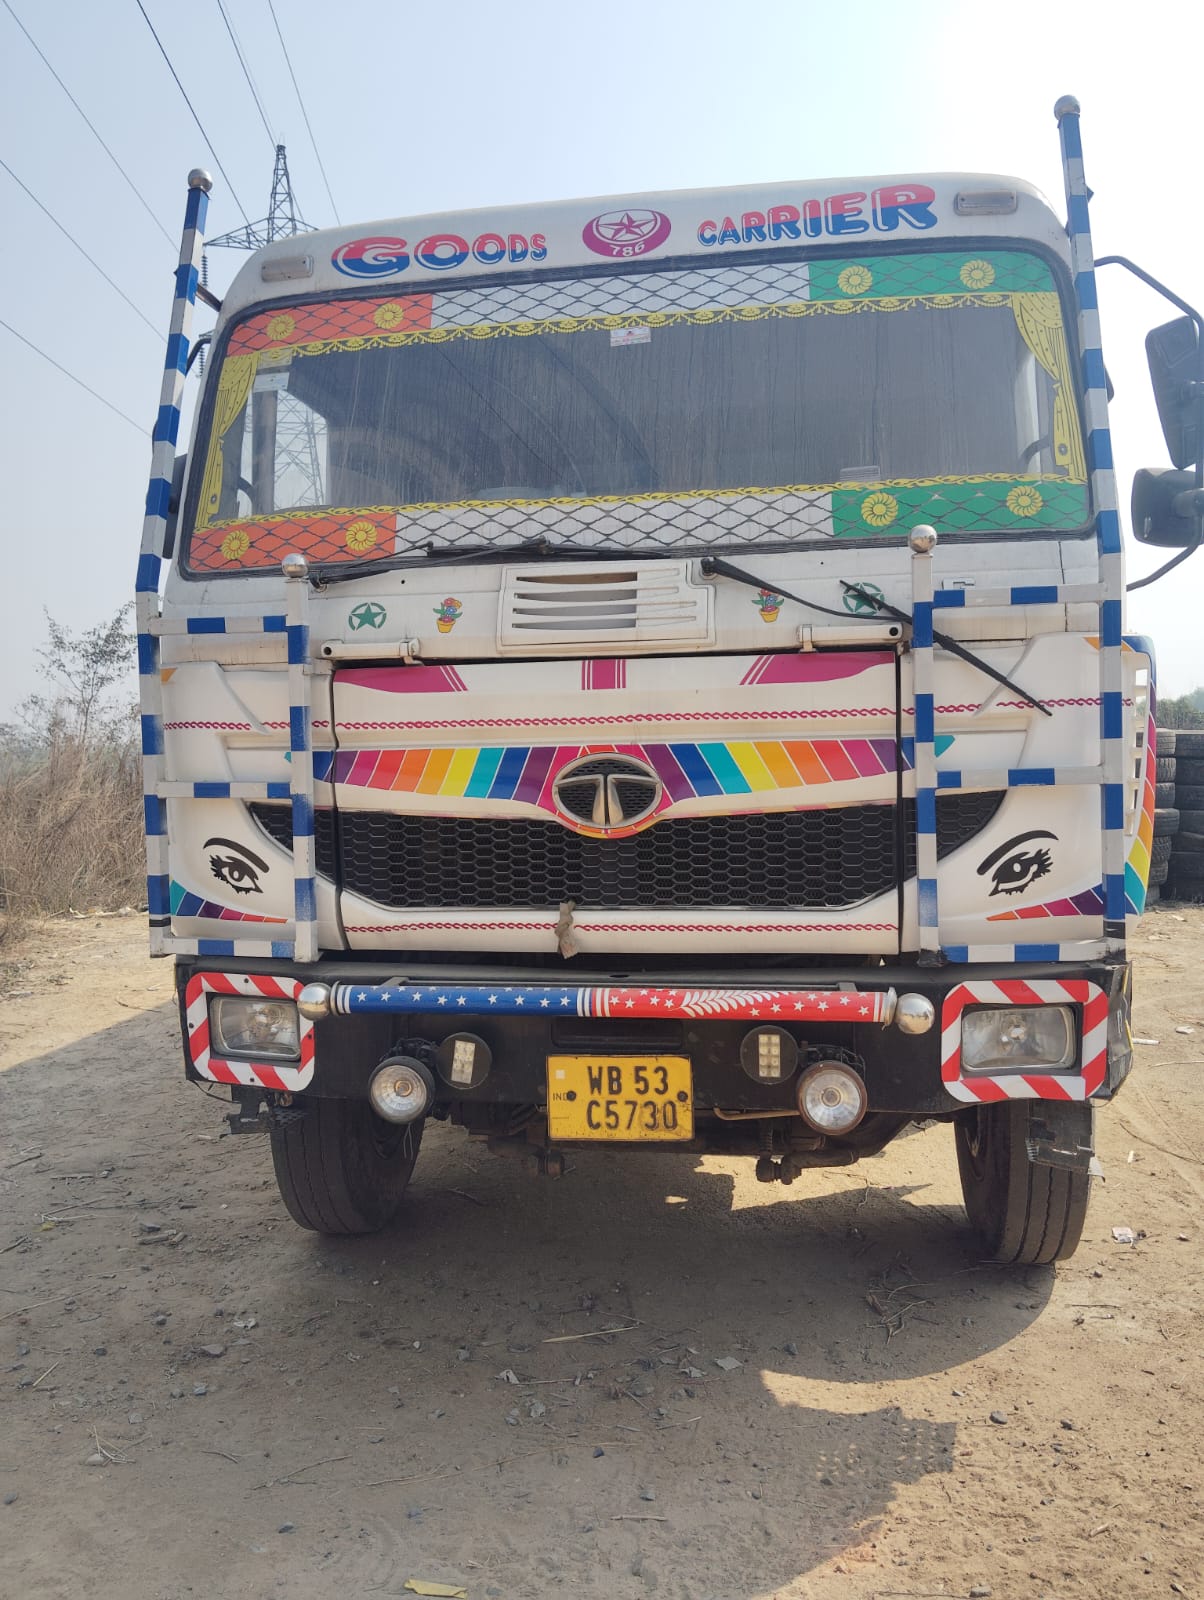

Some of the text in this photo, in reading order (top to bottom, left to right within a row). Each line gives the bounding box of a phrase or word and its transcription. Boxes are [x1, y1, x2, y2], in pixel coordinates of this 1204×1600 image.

[331, 184, 938, 279] GOODS CARRIER
[609, 241, 646, 257] 786
[587, 1065, 669, 1095] WB 53
[586, 1100, 678, 1130] C5730
